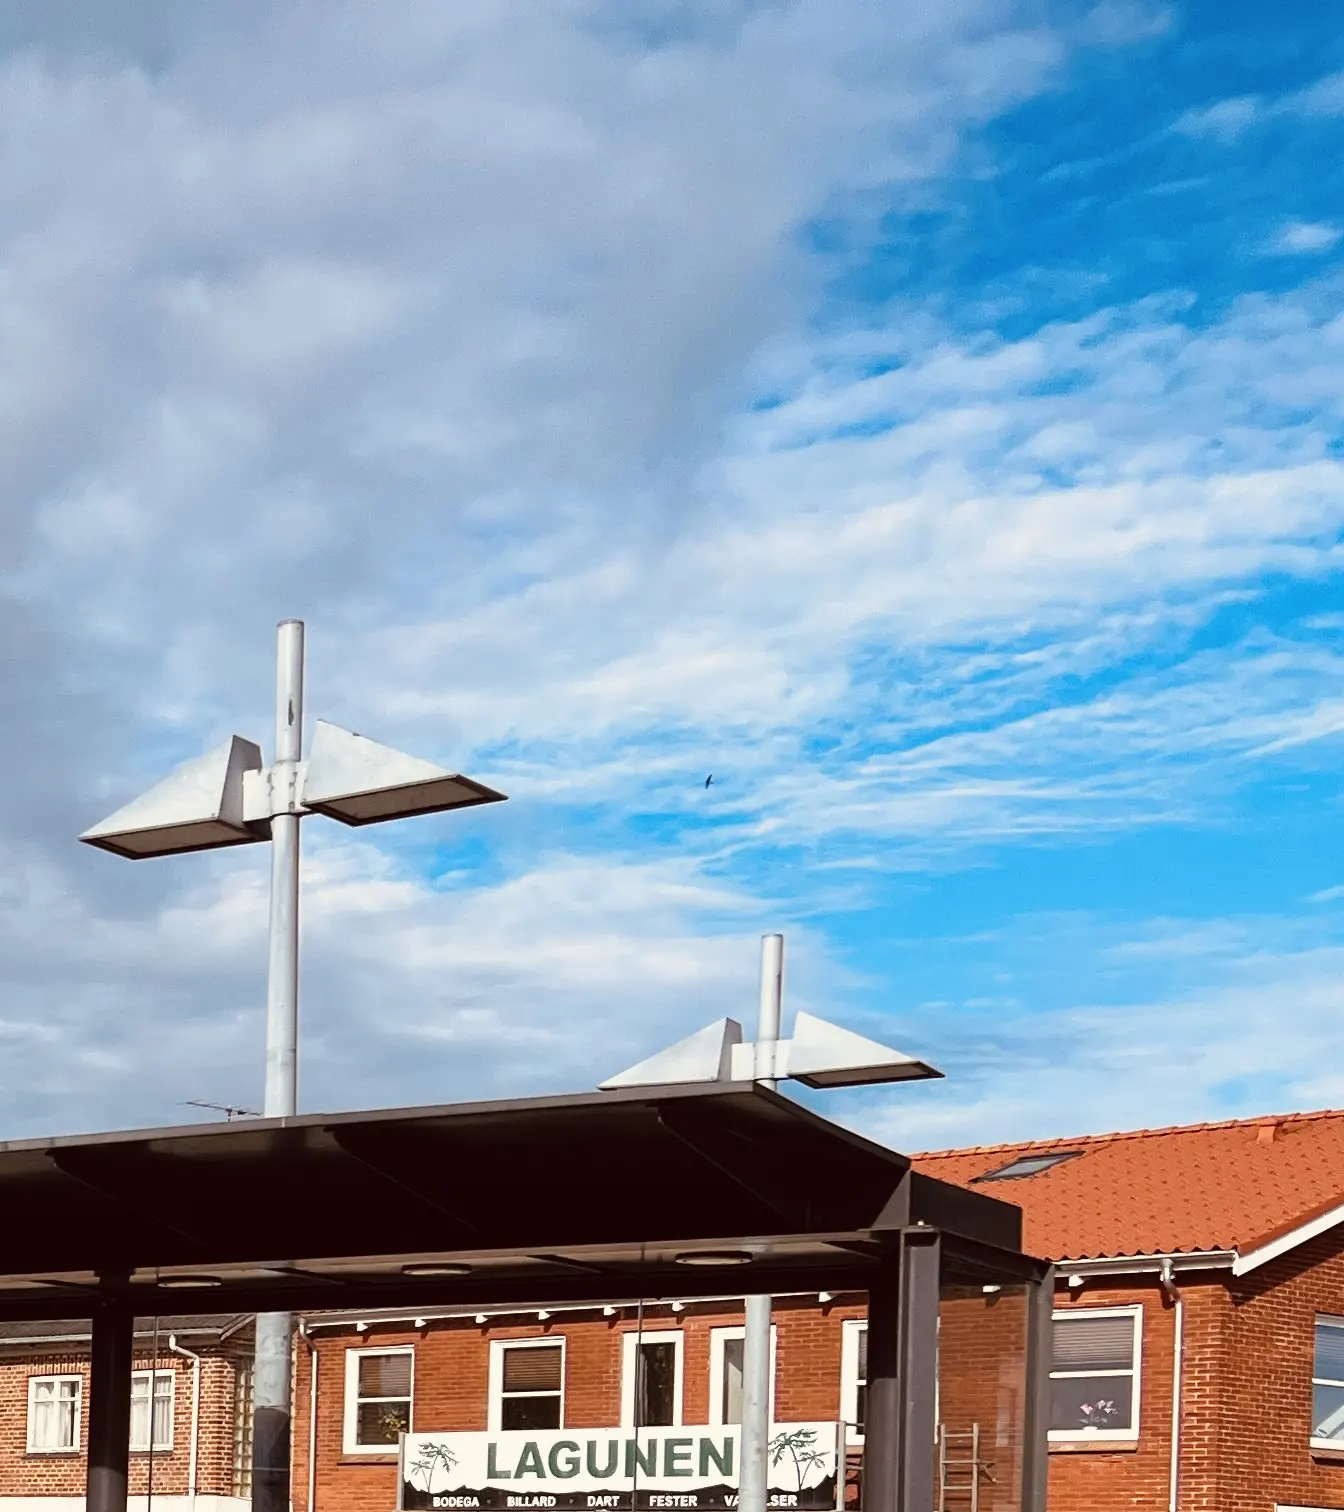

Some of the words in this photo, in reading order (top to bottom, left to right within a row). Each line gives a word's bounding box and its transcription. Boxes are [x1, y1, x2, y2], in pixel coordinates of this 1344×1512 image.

[486, 1437, 734, 1479] LAGUNEN
[433, 1496, 480, 1508] BODEGA
[506, 1496, 557, 1508] BILLARD
[586, 1495, 621, 1507] DART
[649, 1495, 698, 1507] FESTER
